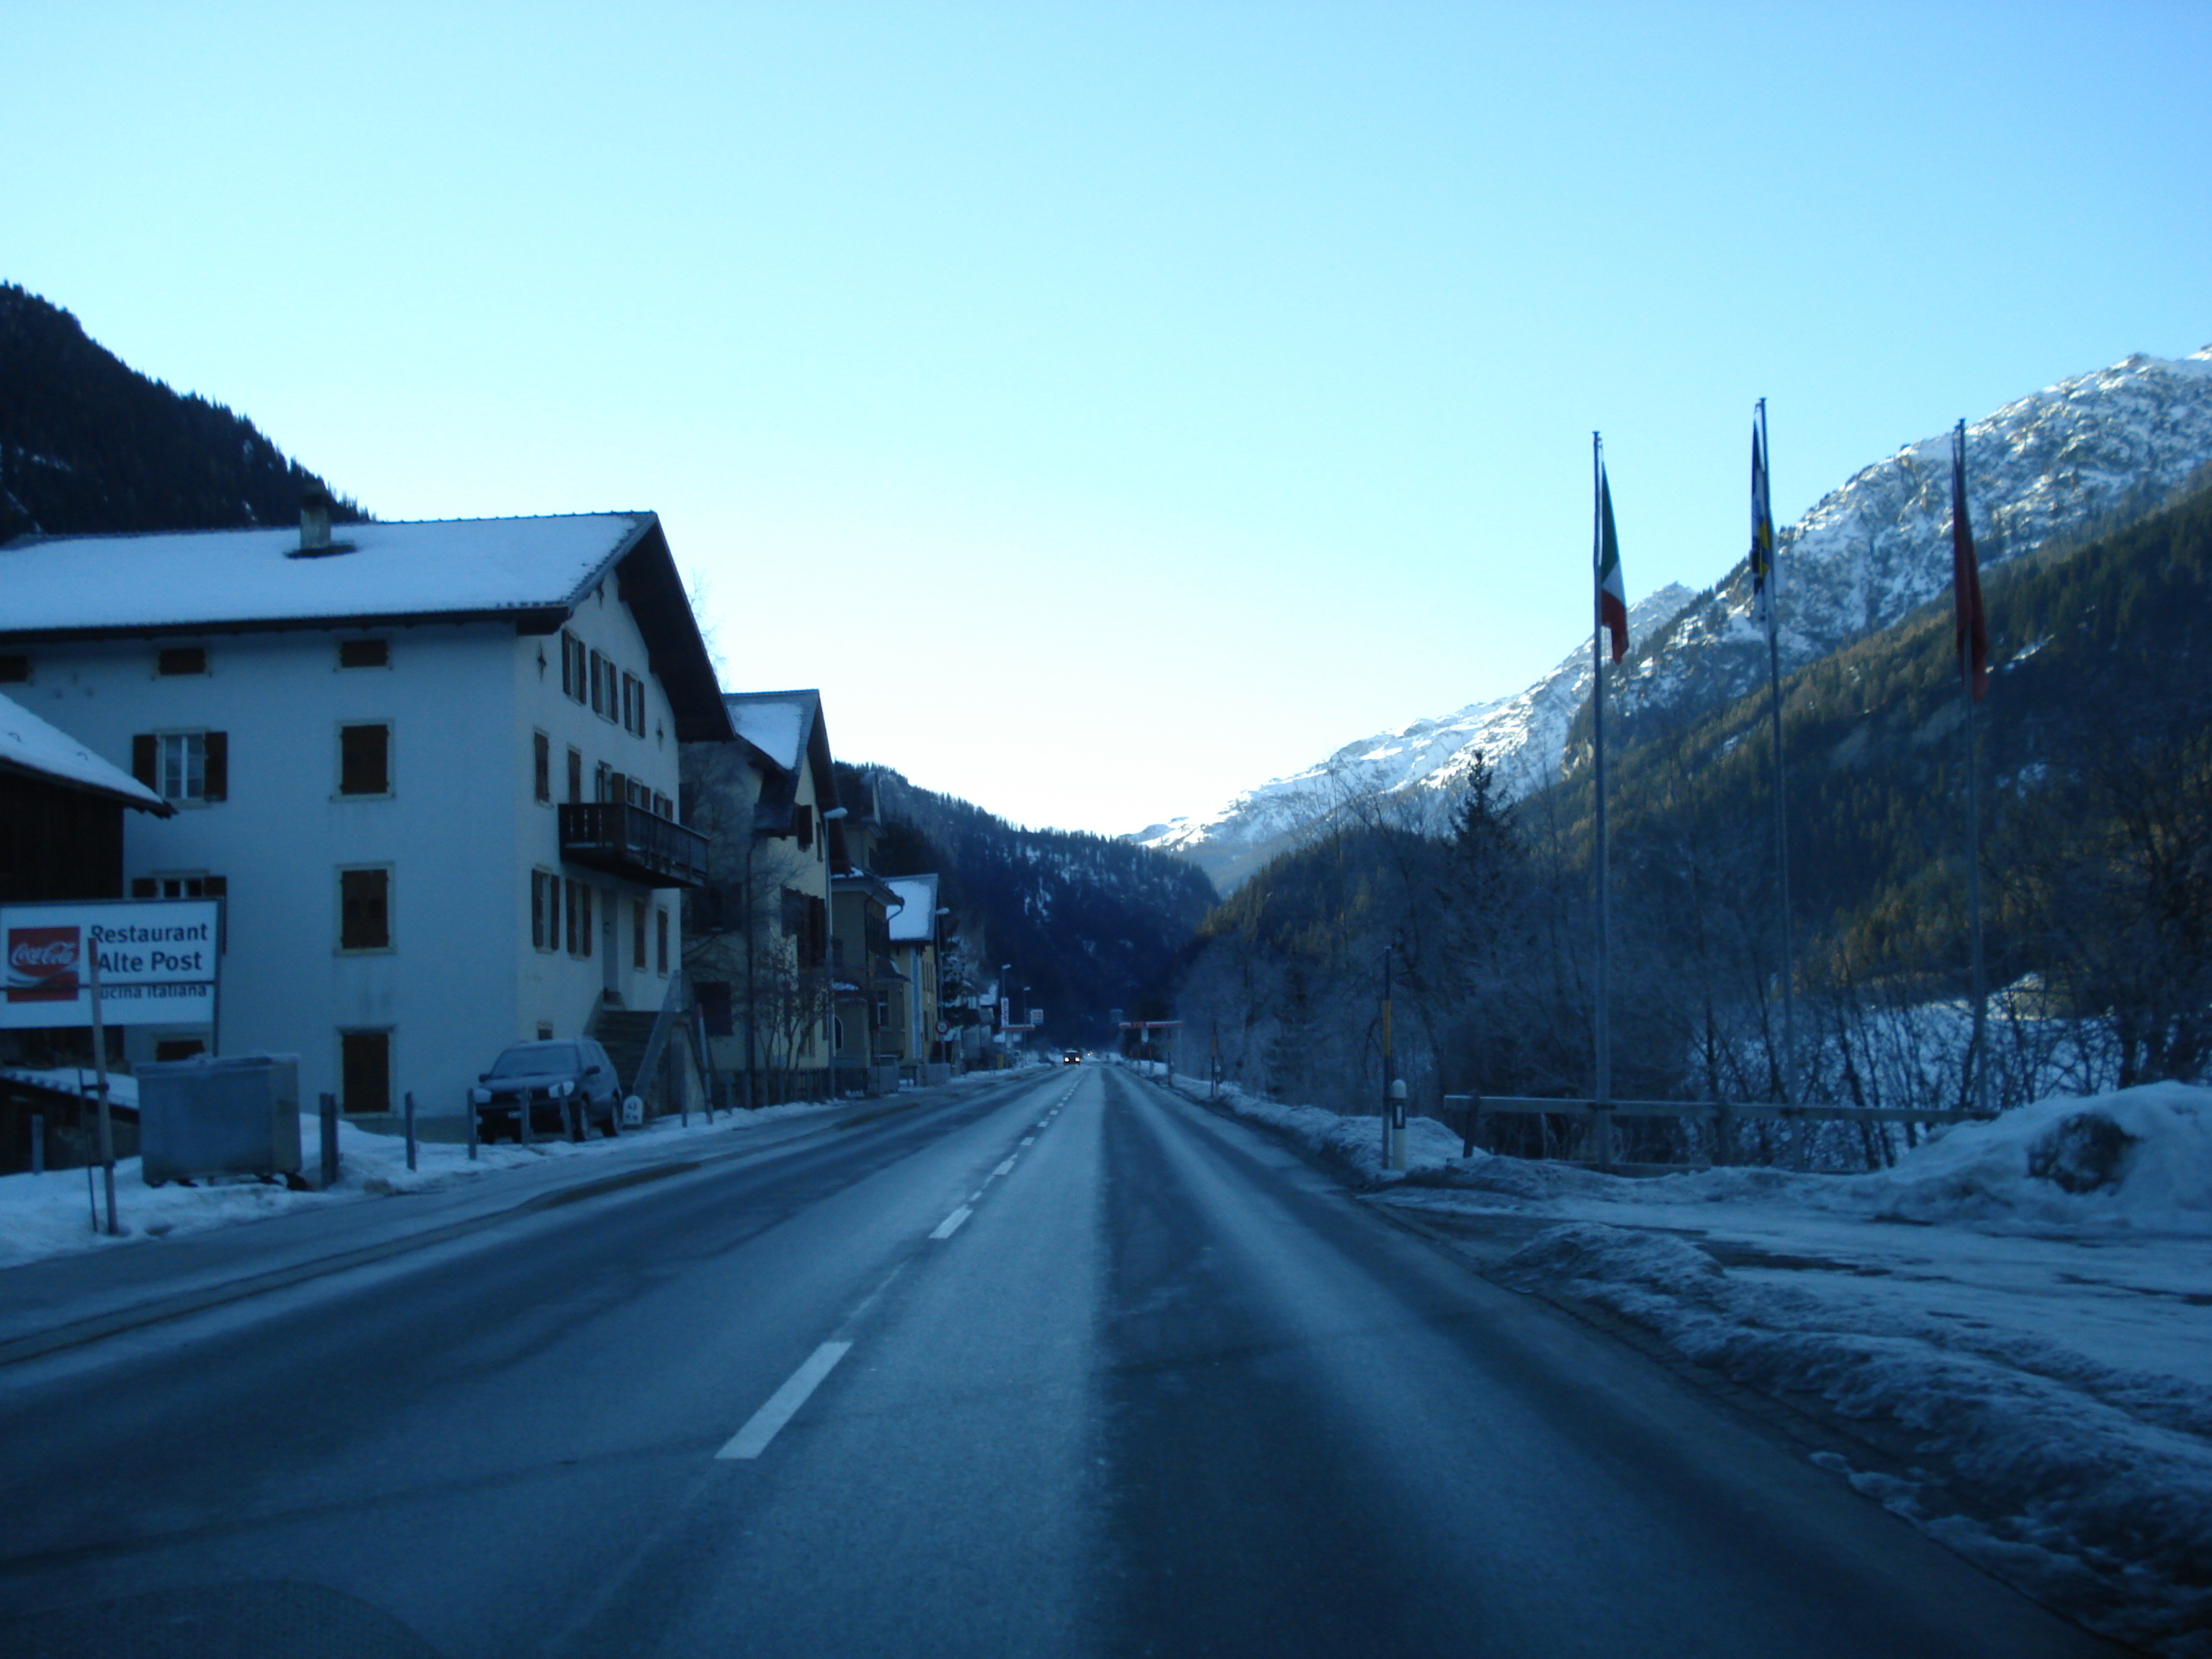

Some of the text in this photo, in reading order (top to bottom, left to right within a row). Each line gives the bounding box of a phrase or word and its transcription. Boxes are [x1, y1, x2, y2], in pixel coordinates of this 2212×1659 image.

[91, 924, 207, 943] Restaurant
[99, 951, 202, 972] Alte Post
[99, 985, 142, 999] ucina
